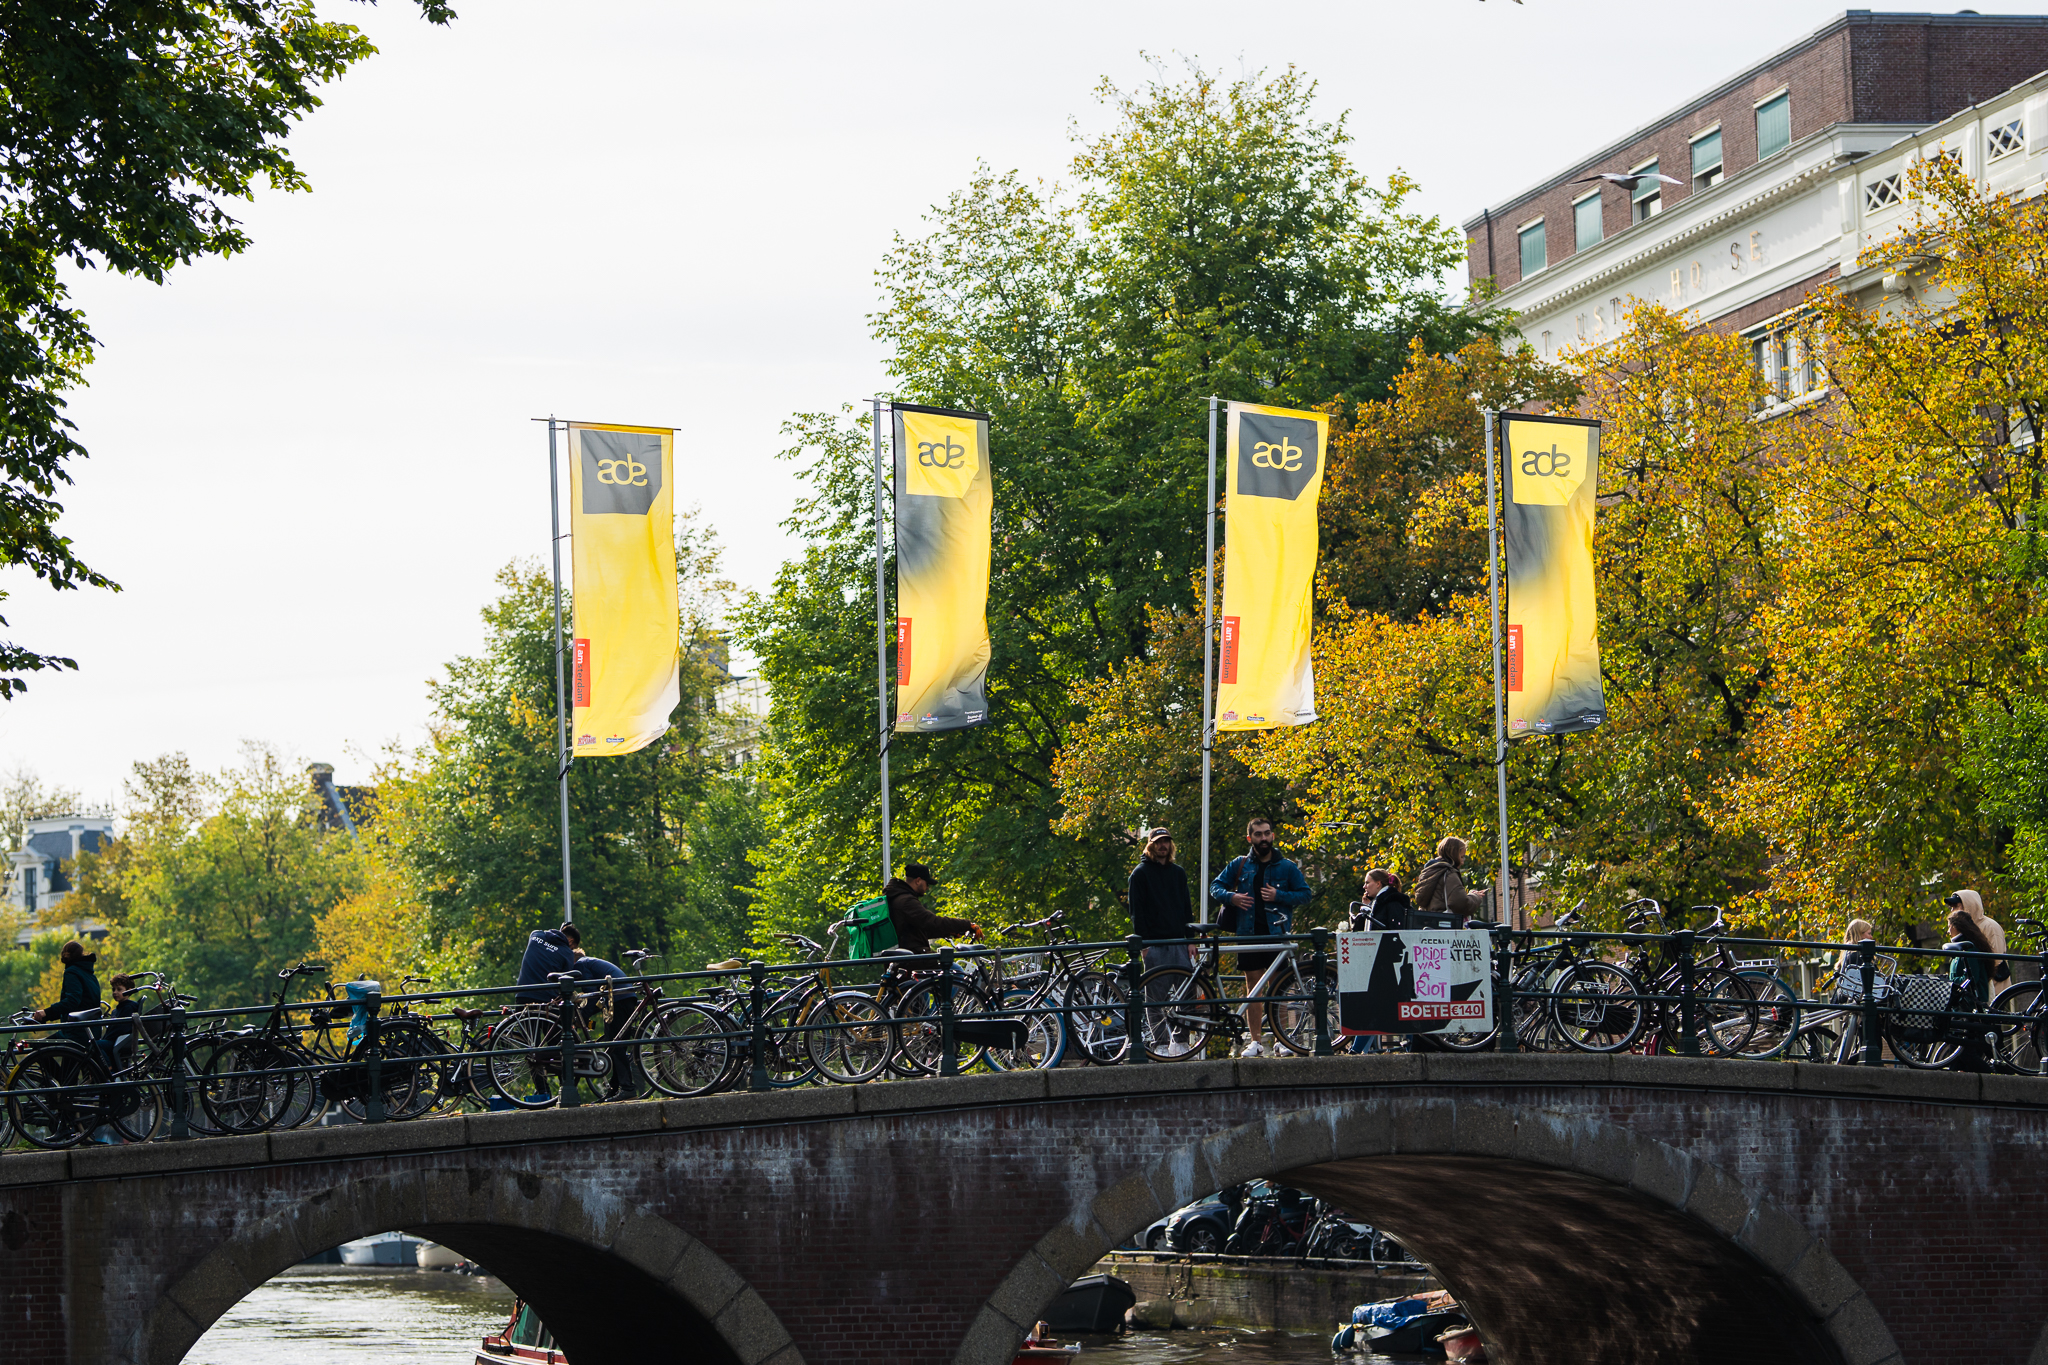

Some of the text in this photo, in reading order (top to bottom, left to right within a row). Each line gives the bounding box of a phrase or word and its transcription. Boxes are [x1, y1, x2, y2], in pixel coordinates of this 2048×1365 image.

[1541, 230, 1762, 357] TUST HOSE
[1419, 971, 1430, 981] A
[1401, 1004, 1481, 1018] BOETE €140
